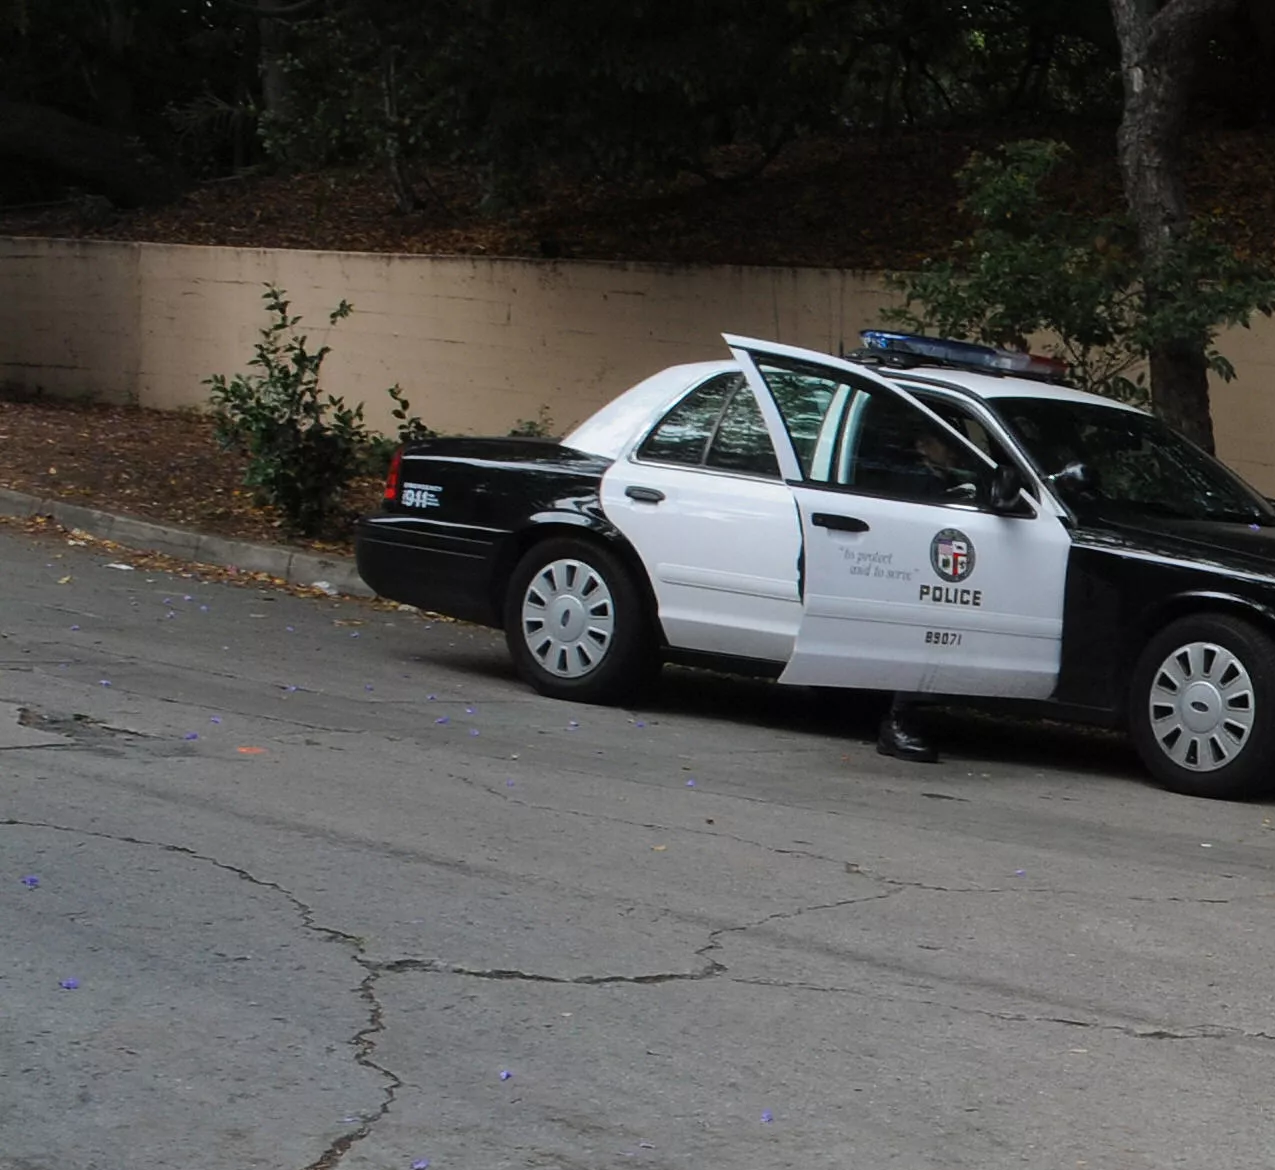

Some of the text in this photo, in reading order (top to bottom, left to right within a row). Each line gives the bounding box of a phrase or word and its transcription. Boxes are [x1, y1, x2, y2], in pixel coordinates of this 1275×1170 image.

[856, 551, 893, 565] protect
[850, 563, 871, 577] and
[919, 584, 982, 607] POLICE
